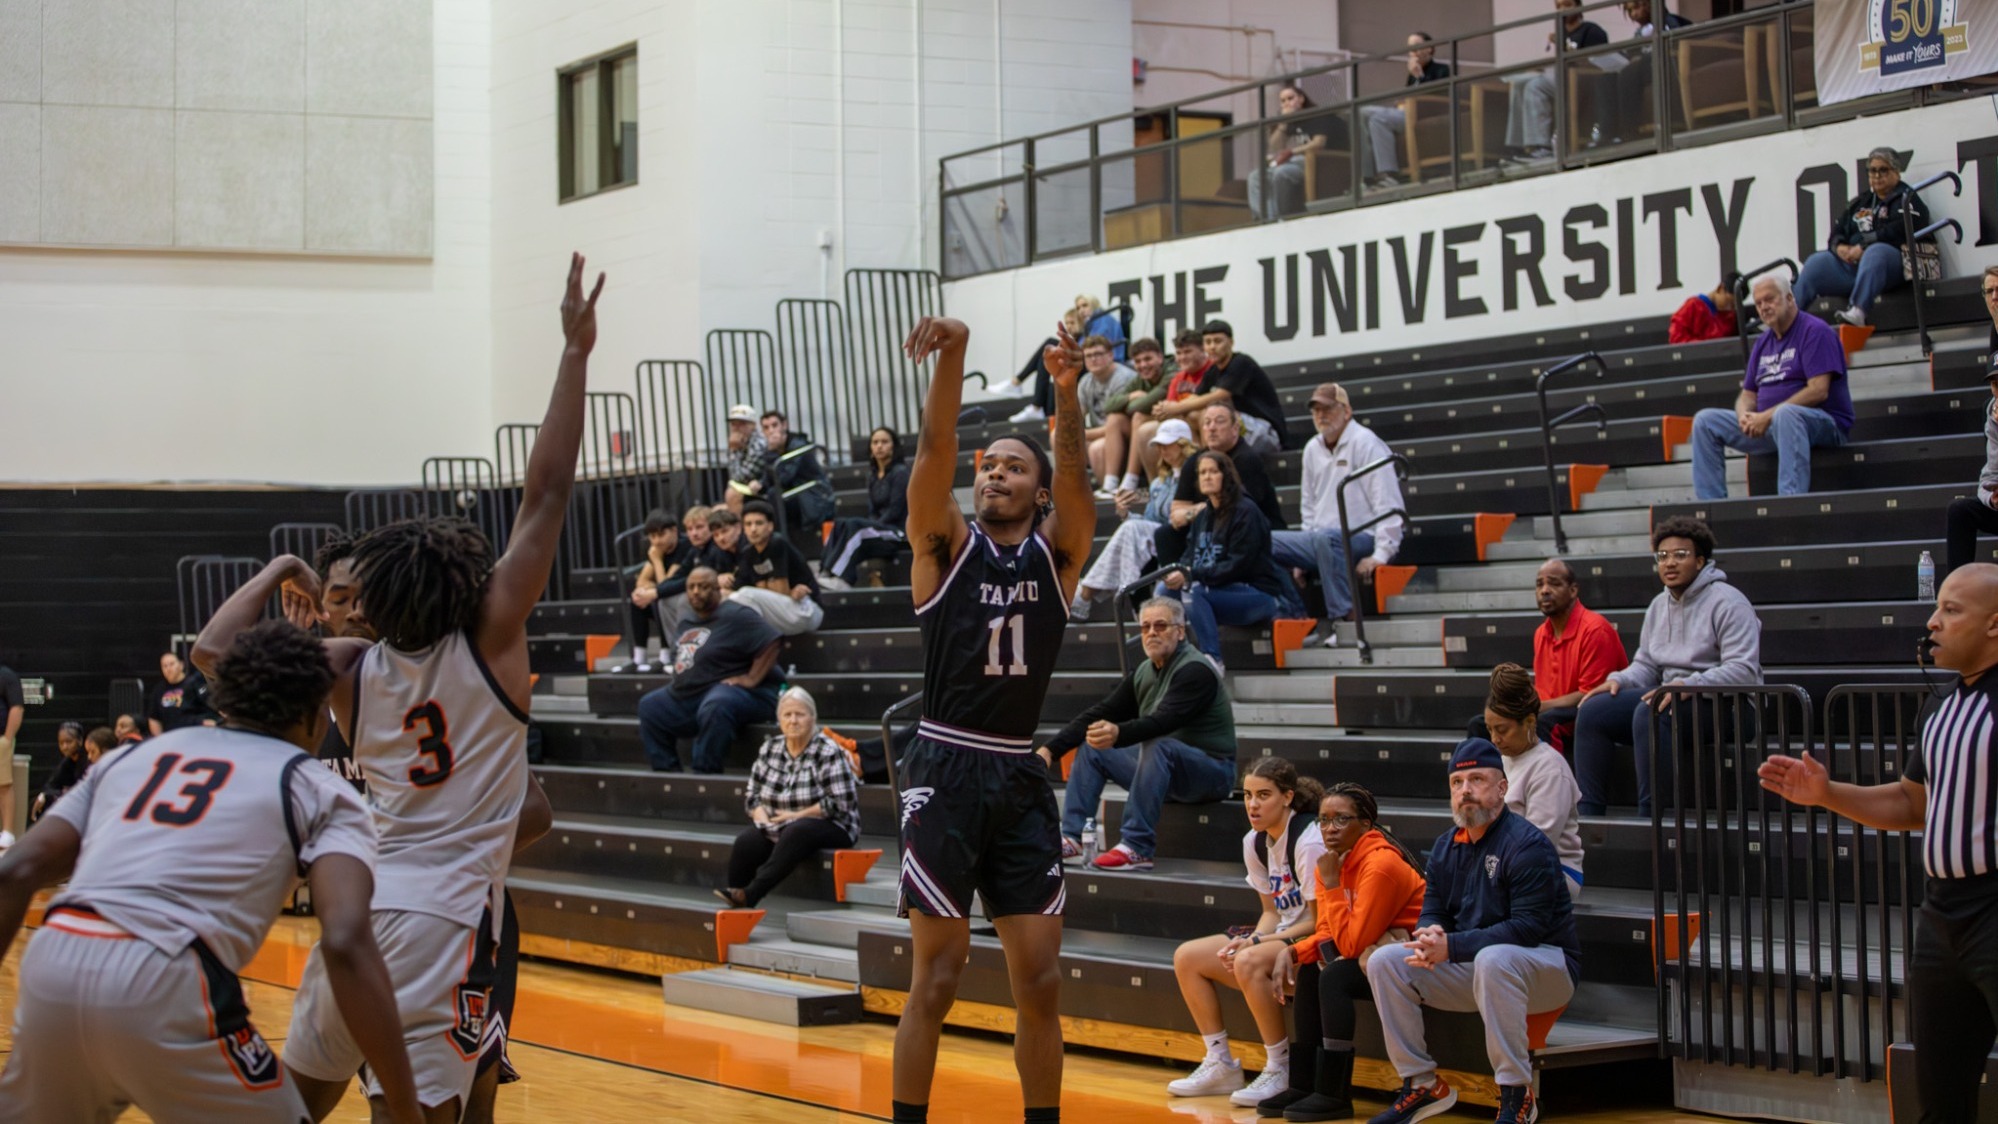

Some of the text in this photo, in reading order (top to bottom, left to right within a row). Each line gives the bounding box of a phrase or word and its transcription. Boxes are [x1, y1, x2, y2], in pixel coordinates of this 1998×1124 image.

[1885, 42, 1941, 65] MAKE IT YOURS
[1891, 0, 1933, 42] 50
[1108, 264, 1230, 358] THE
[1258, 176, 1755, 342] UNIVERSITY
[1796, 149, 1914, 263] O
[984, 614, 1029, 675] 11
[402, 698, 455, 789] 3
[122, 753, 235, 828] 13
